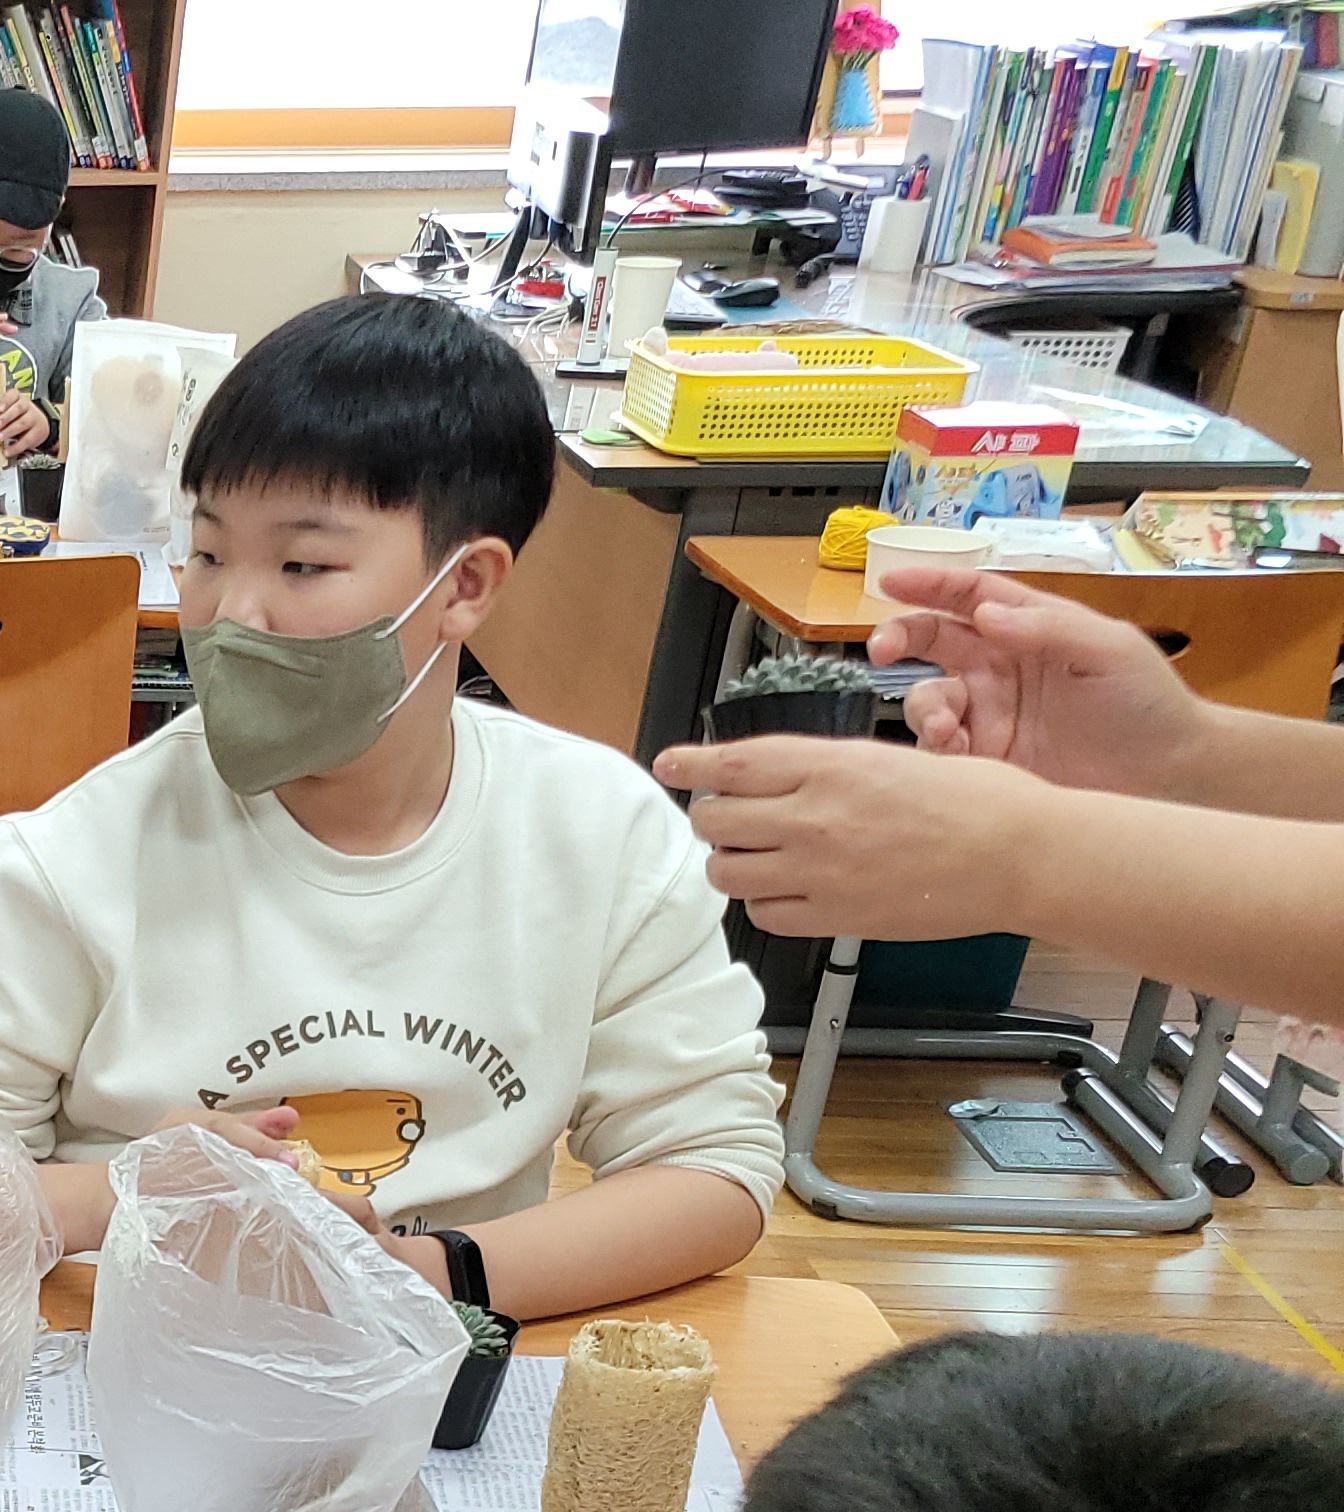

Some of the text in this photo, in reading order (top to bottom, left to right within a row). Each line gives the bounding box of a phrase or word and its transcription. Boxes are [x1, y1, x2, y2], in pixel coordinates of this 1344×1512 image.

[199, 1009, 529, 1113] A SPECIAL WINTER
